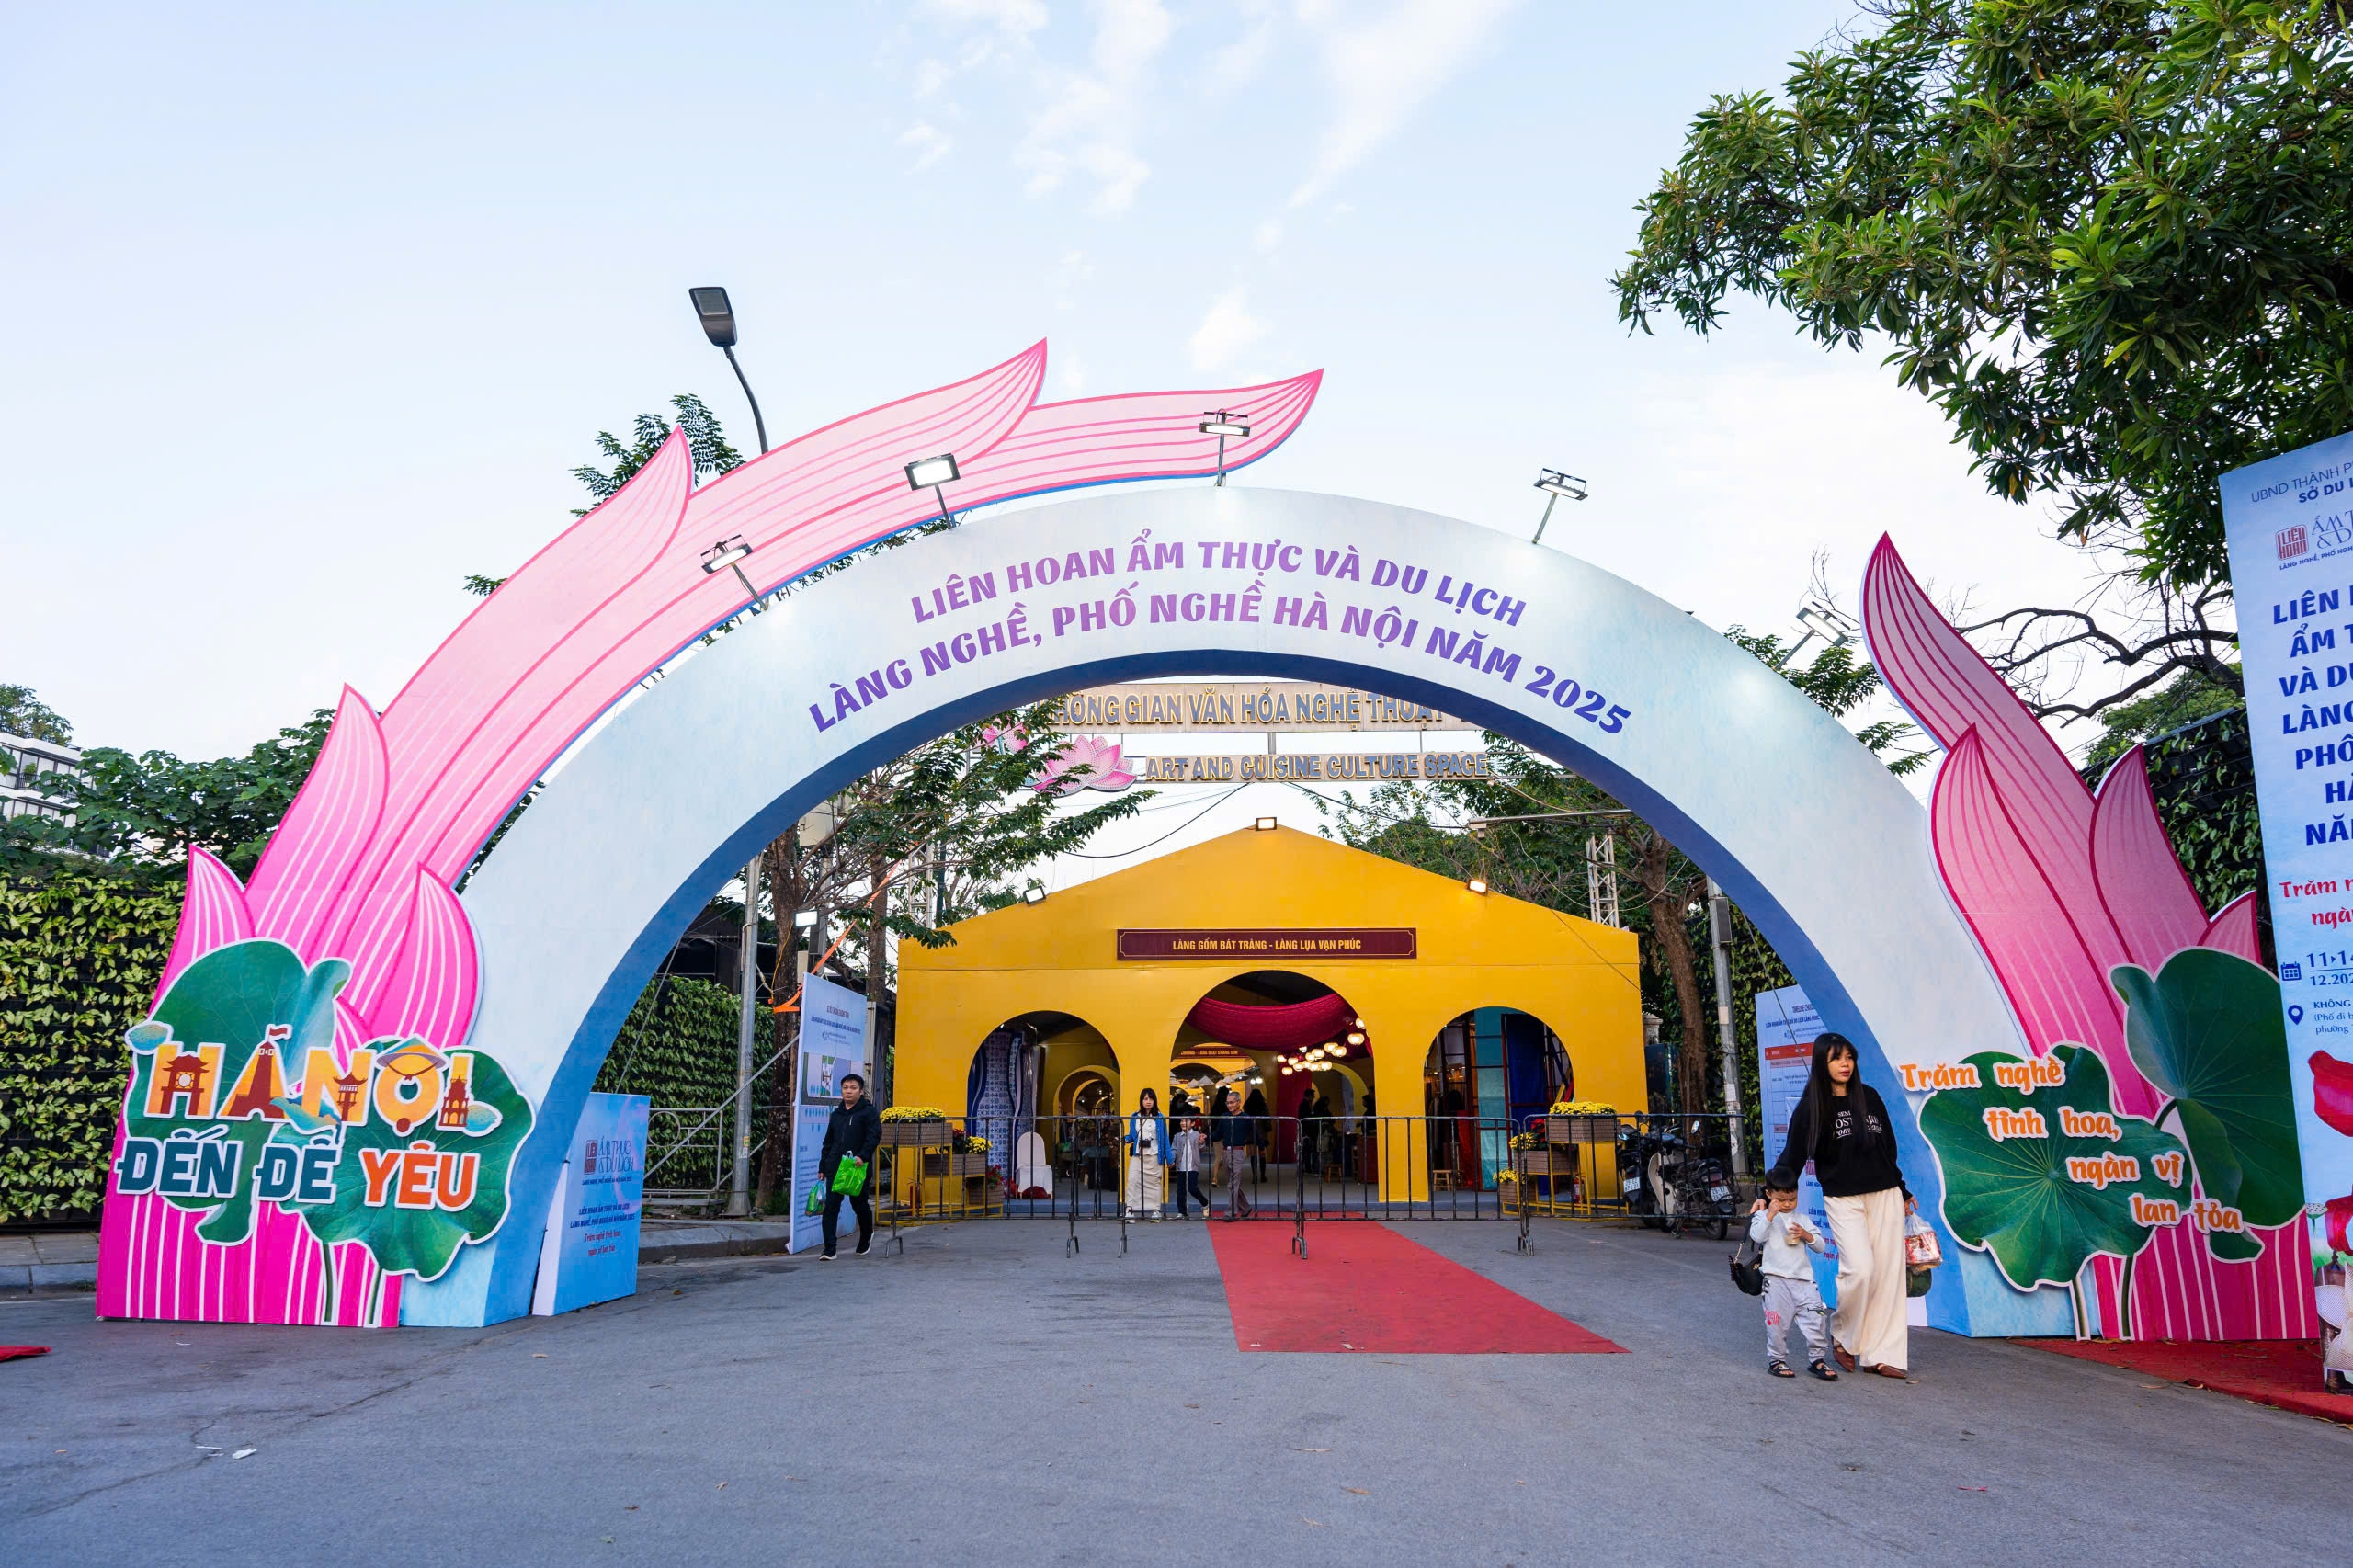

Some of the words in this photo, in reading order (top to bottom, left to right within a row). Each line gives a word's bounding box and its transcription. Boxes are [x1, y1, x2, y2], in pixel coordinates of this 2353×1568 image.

[2251, 483, 2289, 503] UBND
[2291, 466, 2339, 490] THÀNH
[2299, 485, 2319, 503] SỞ
[2324, 480, 2344, 495] DU
[2337, 545, 2353, 555] NGH
[912, 573, 997, 623] LIÊN
[1006, 547, 1115, 592] HOAN
[1127, 528, 1184, 572] ẨM
[1198, 538, 1302, 577] THỰC
[1314, 545, 1361, 582] VÀ
[1371, 559, 1428, 595] DU
[1435, 575, 1527, 627] LỊCH
[2274, 589, 2339, 625] LIÊN
[809, 659, 913, 733] LÀNG
[919, 602, 1042, 677] NGHỀ,
[1052, 581, 1140, 636] PHỐ
[1150, 579, 1266, 624] NGHỀ
[1273, 591, 1329, 631] HÀ
[1341, 606, 1418, 648] NỘI
[1425, 631, 1522, 683] NĂM
[1525, 666, 1632, 734] 2025
[2290, 622, 2336, 658] ẨM
[2279, 666, 2319, 697] VÀ
[1124, 693, 1183, 724] GIAN
[1187, 686, 1235, 724] VĂN
[1241, 686, 1290, 723] HÓA
[1294, 688, 1361, 731] NGHỆ
[1147, 756, 1188, 781] ART
[1191, 756, 1235, 780] AND
[1241, 755, 1322, 780] CUISINE
[1326, 754, 1420, 779] CULTURE
[1425, 753, 1488, 778] SPACE
[2305, 812, 2353, 846] NĂ
[2279, 880, 2337, 898] Trăm
[2312, 906, 2353, 929] ngà
[1173, 938, 1196, 950] LÀNG
[1198, 937, 1218, 950] GỐM
[1238, 938, 1267, 950] TRÀNG
[1275, 938, 1298, 949] LÀNG
[1300, 940, 1316, 951] LỤA
[1318, 940, 1336, 951] VẠN
[1338, 938, 1361, 949] PHÚC
[2313, 999, 2351, 1009] KHÔNG
[2313, 1013, 2335, 1023] (Phố
[2315, 1024, 2349, 1036] phường
[1900, 1063, 1976, 1088] Trăm
[1996, 1056, 2063, 1092] nghề
[1986, 1108, 2043, 1139] tinh
[2062, 1108, 2119, 1140] hoa,
[117, 1127, 238, 1194] ĐẾN
[361, 1142, 476, 1208] YÊU
[2070, 1154, 2137, 1187] ngàn
[2154, 1153, 2181, 1185] vị
[2131, 1196, 2177, 1223] lan
[2194, 1201, 2240, 1231] tỏa
